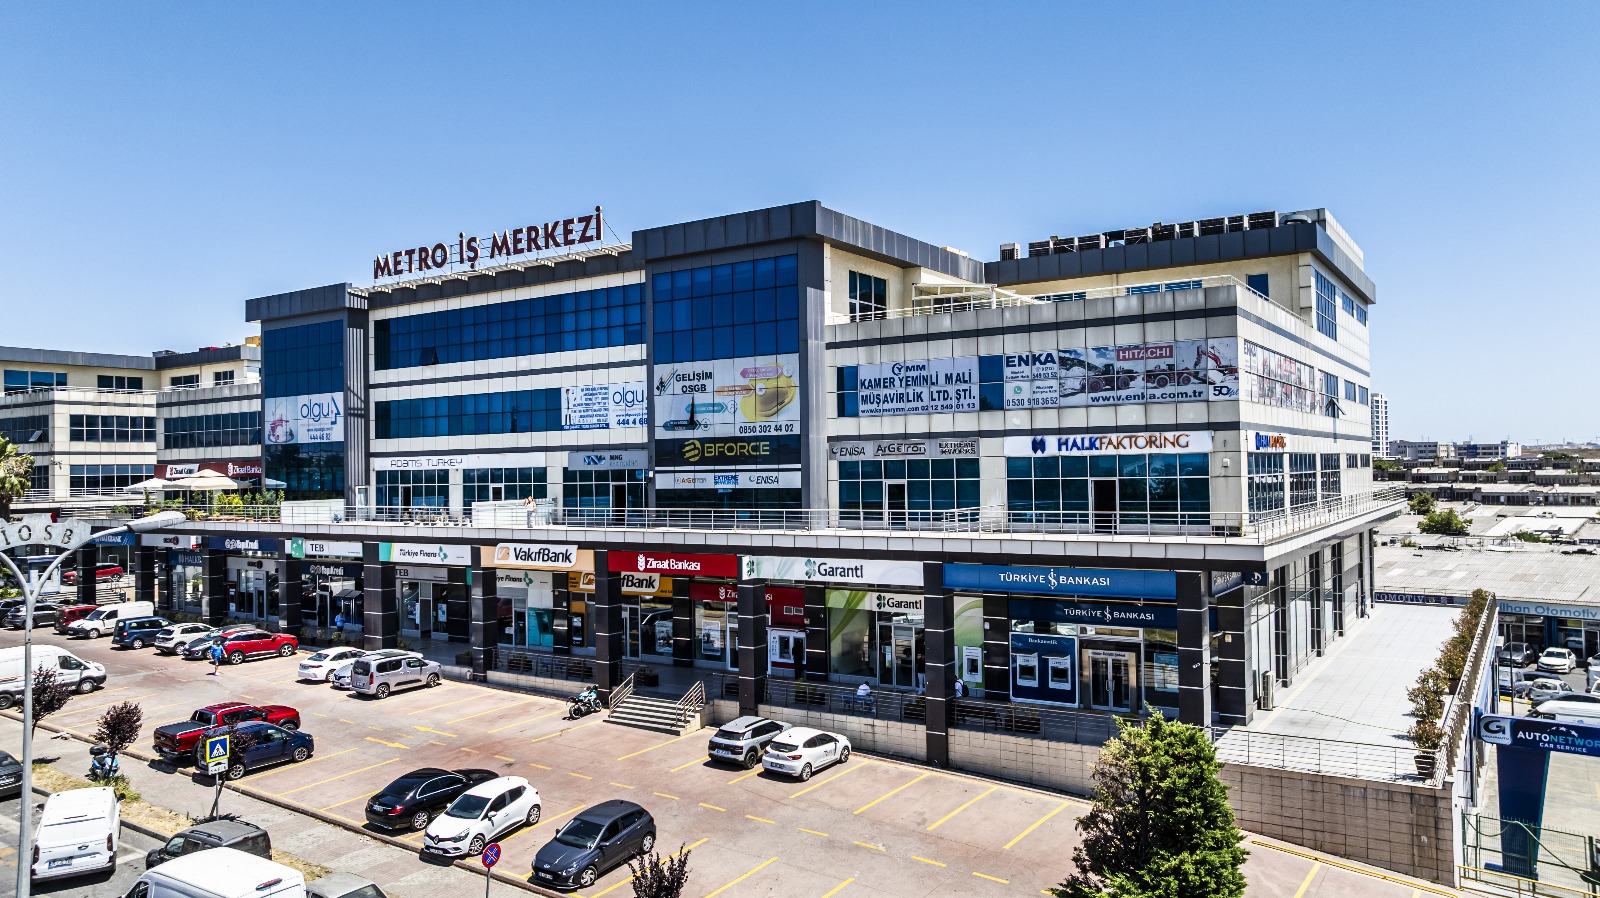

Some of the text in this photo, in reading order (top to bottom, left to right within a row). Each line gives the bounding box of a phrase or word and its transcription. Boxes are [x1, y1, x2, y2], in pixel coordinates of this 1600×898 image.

[374, 206, 603, 279] METRO İŞ MERKEZİ
[1119, 347, 1170, 359] HITACHI
[1005, 353, 1057, 367] ENKA
[675, 370, 713, 382] GELİŞİM
[860, 368, 972, 390] KAMER YEMİNLİ MALİ
[681, 383, 707, 394] OSGB
[612, 386, 645, 408] olgu
[860, 385, 976, 407] MÜŞAVİRLİK LTD. ŞTİ.
[1006, 396, 1059, 407] 0 530 918 36 52
[1090, 390, 1204, 403] www.enka.com.tr
[955, 402, 965, 410] 01
[616, 418, 630, 426] 444
[739, 423, 794, 434] 0850 302 44 02
[1058, 432, 1191, 452] HALKFAKTORİNG
[704, 441, 770, 457] BFORCE
[310, 543, 325, 552] TEB
[419, 549, 437, 558] Finans
[514, 547, 573, 563] VakıfBank
[647, 558, 701, 571] Ziraat Bankası
[818, 563, 864, 578] Garanti
[621, 574, 656, 589] fBank
[999, 572, 1046, 583] TÜRKİYE
[1059, 576, 1110, 586] BANKASI
[886, 597, 922, 610] Garanti
[1063, 607, 1103, 617] TÜRKİYE
[1113, 611, 1155, 620] BANKASI
[1534, 605, 1598, 618] Otomotiv
[1556, 744, 1588, 753] SERVICE
